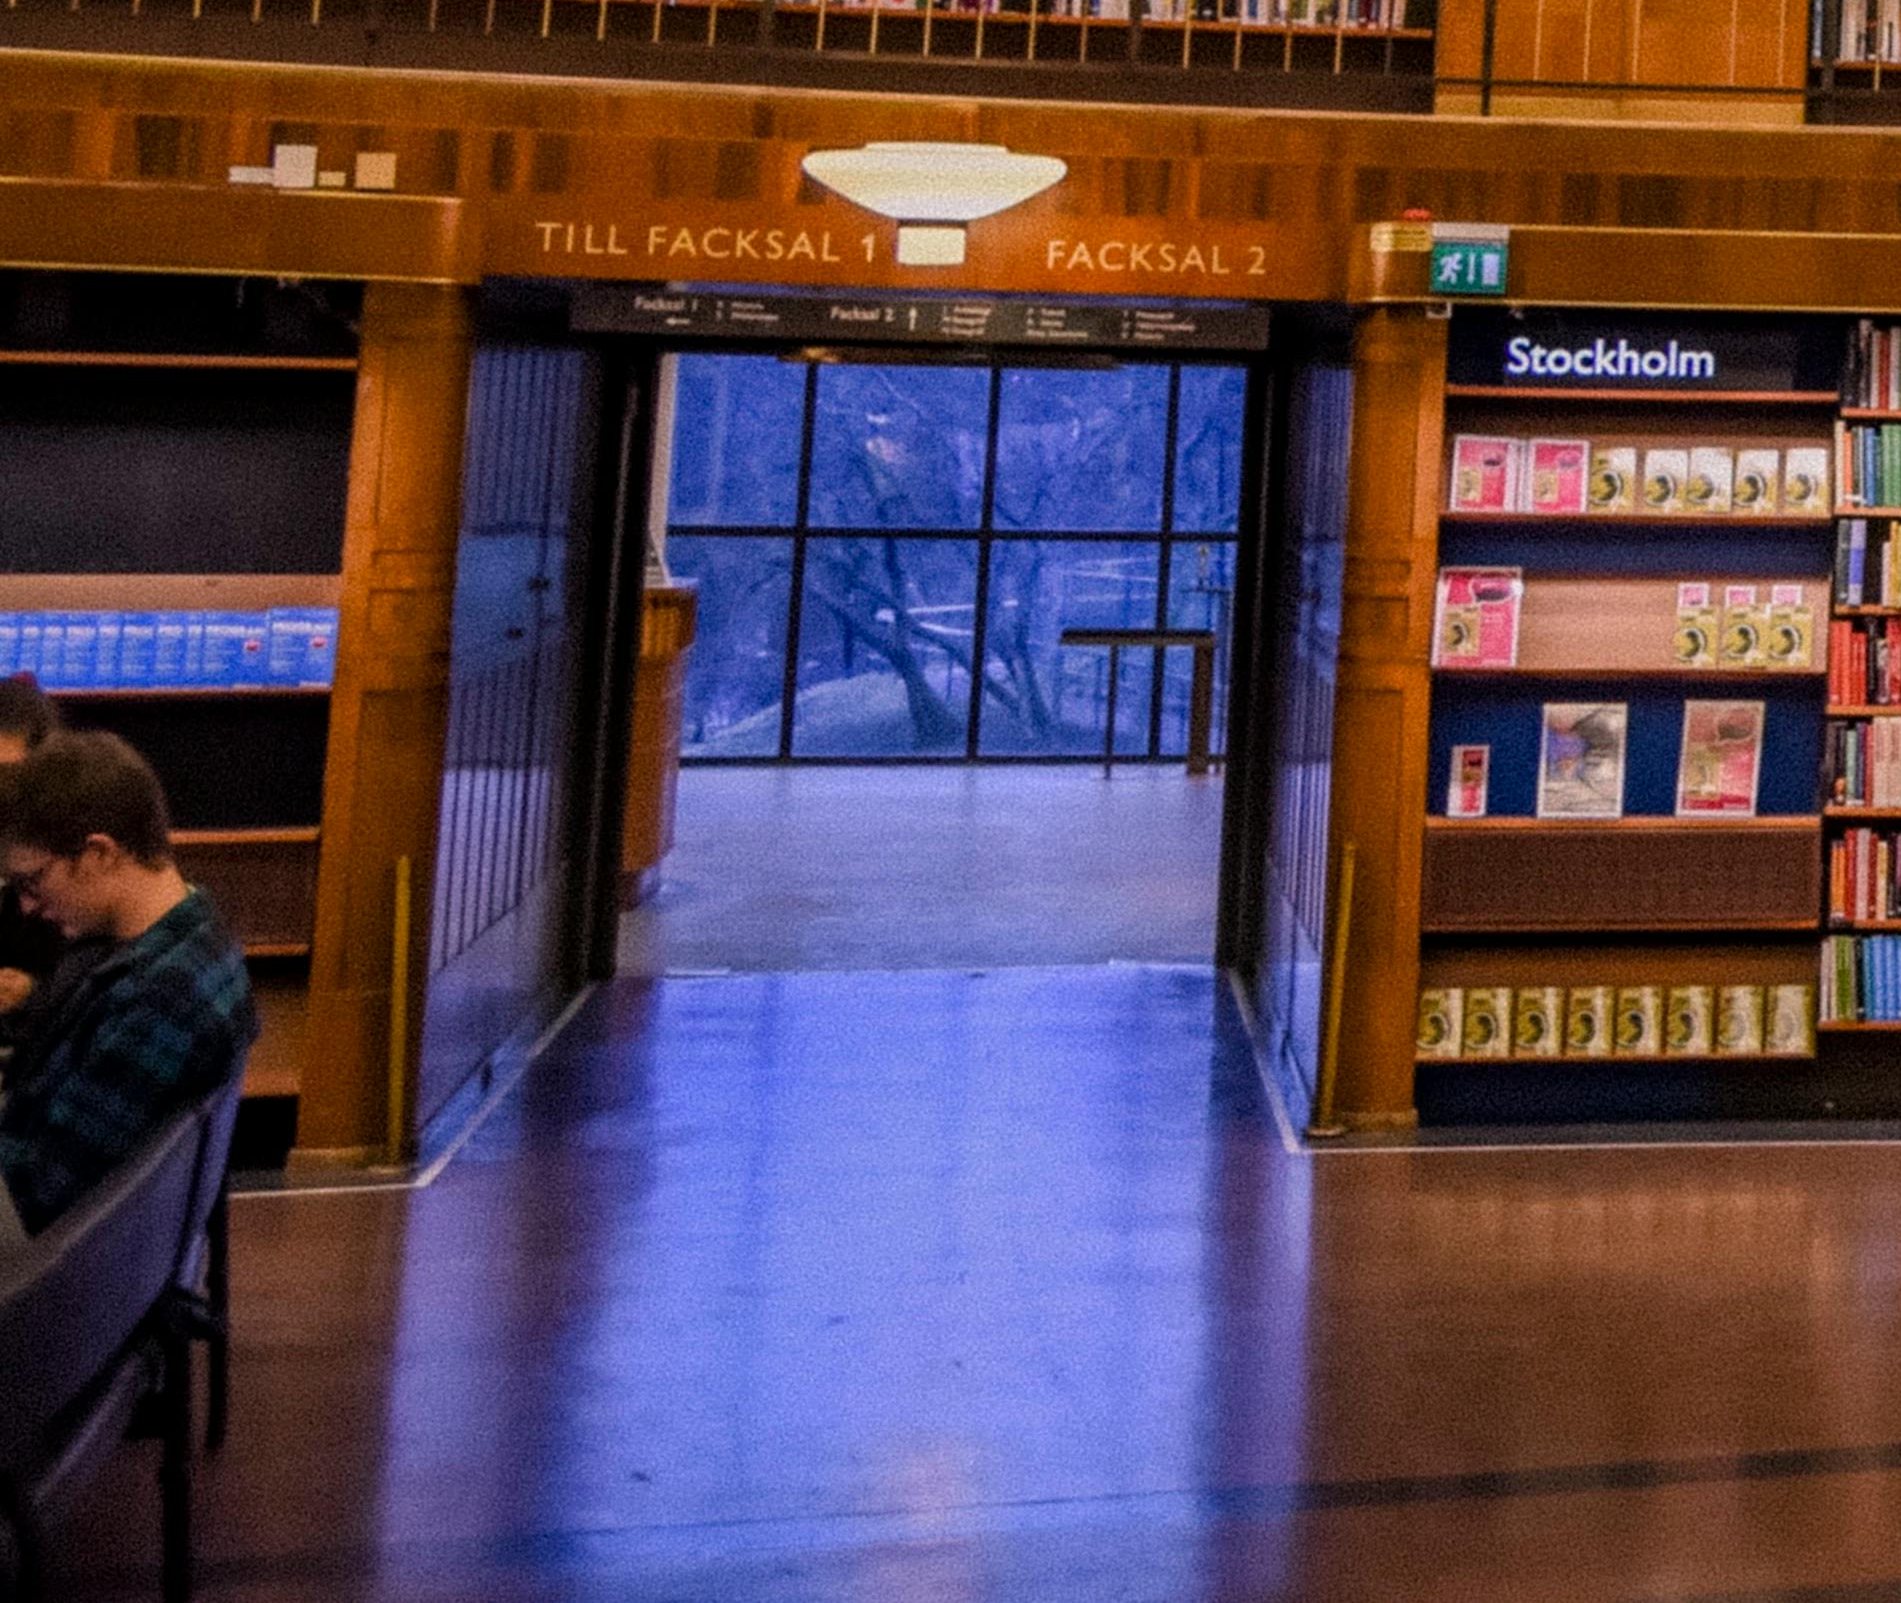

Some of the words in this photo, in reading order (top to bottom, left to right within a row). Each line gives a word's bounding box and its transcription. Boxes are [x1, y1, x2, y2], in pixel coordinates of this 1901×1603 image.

[535, 221, 628, 255] TILL
[648, 225, 841, 263] FACKSAL
[861, 233, 877, 263] 1
[1046, 240, 1230, 274] FACKSAL
[1246, 246, 1267, 274] 2
[1506, 336, 1715, 379] Stockholm
